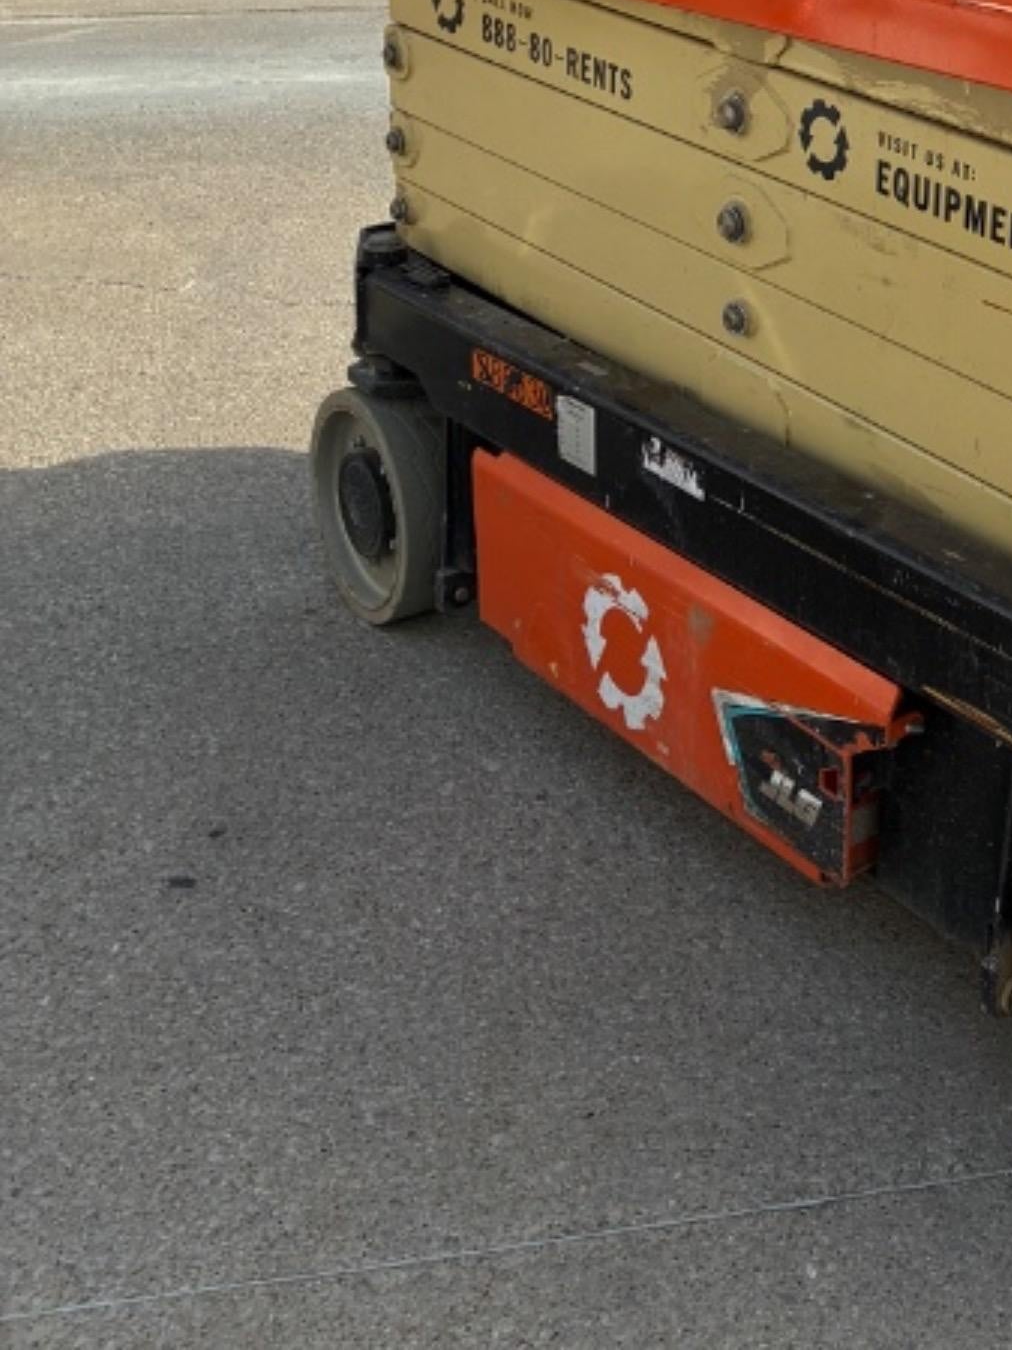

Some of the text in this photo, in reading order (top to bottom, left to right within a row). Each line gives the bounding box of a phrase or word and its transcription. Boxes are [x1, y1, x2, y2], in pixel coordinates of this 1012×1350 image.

[481, 14, 634, 100] 888-80-RENTS
[877, 130, 976, 181] VISIT US AT:
